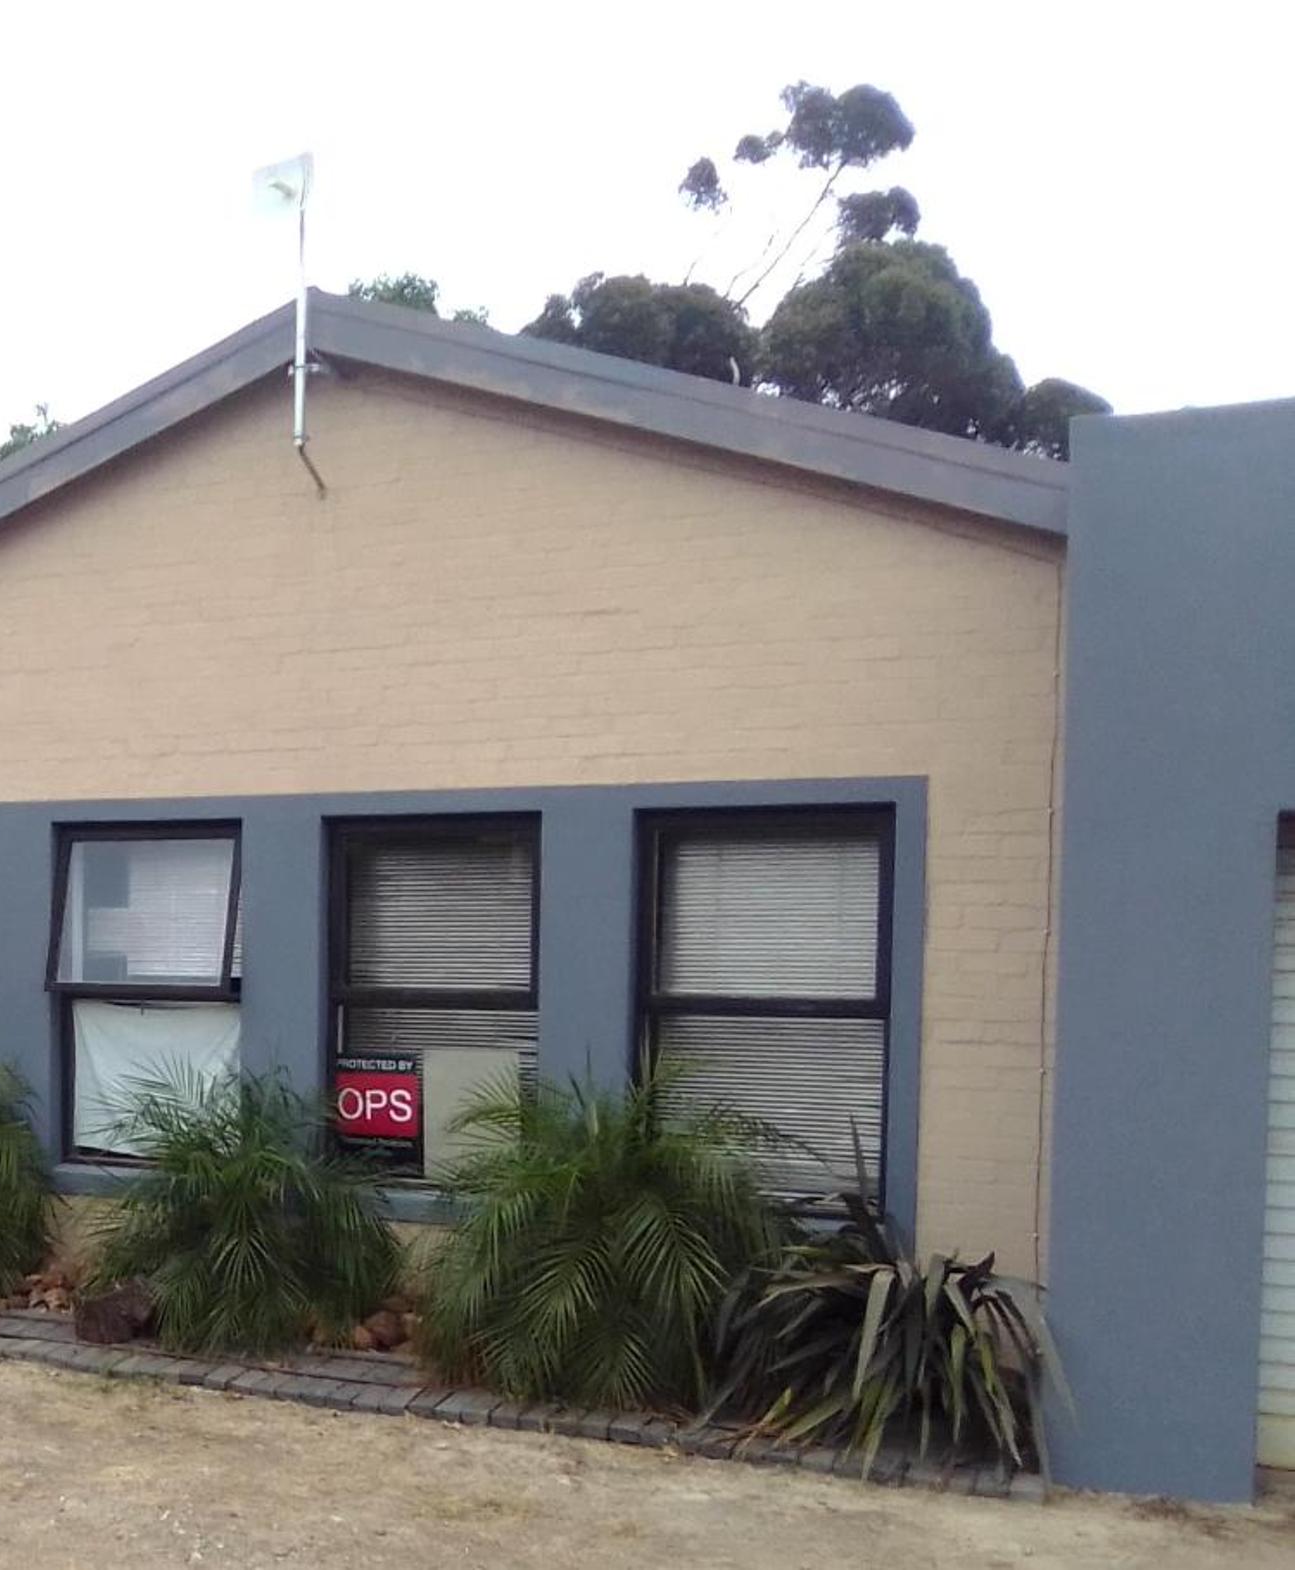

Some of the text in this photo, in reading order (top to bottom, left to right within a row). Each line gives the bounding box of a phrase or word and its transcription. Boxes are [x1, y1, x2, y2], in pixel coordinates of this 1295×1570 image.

[338, 1059, 413, 1070] PROTECTED BY
[338, 1088, 412, 1122] OPS
